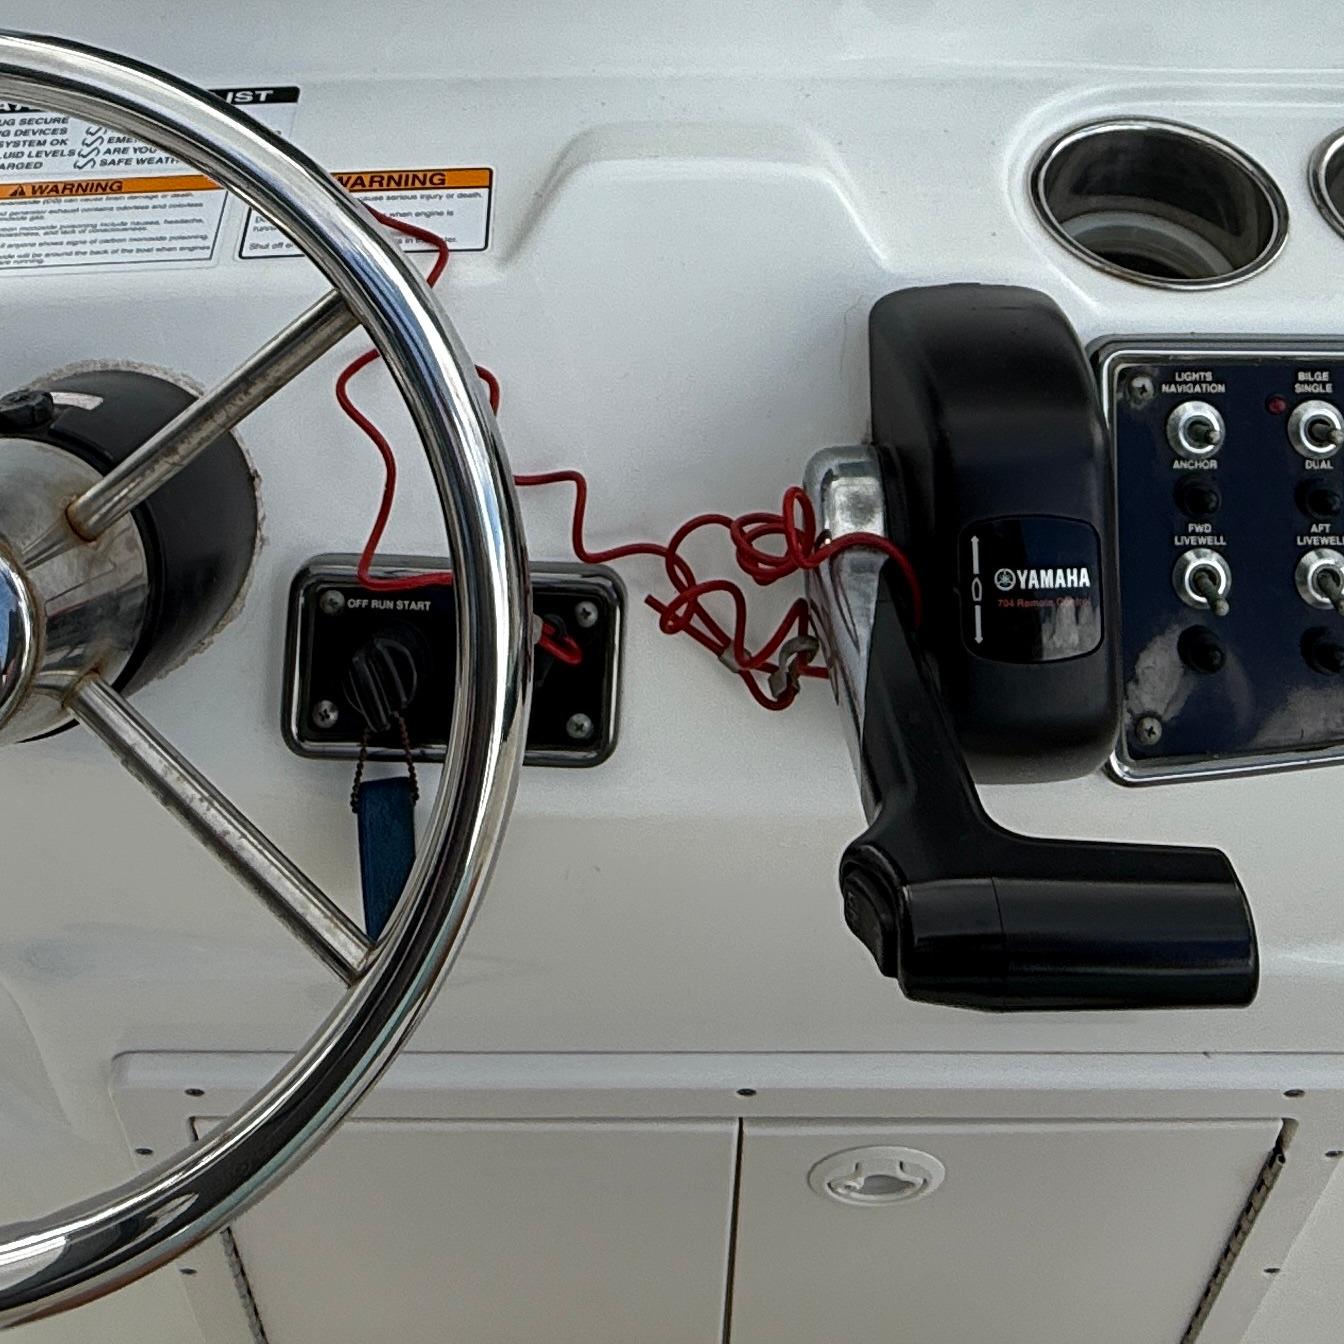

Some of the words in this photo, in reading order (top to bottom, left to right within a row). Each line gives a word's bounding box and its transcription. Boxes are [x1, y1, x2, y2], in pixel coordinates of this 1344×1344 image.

[19, 116, 70, 127] SECURE
[13, 127, 68, 138] DEVICES
[49, 137, 70, 147] OK
[26, 148, 76, 159] LEVELS
[103, 146, 131, 155] ARE
[99, 158, 134, 167] SAFE
[337, 172, 447, 189] WARNING
[31, 180, 124, 196] WARNING
[419, 193, 444, 201] injury
[414, 210, 445, 219] engine
[446, 209, 455, 217] is
[1174, 371, 1213, 382] LIGHTS
[1297, 371, 1330, 382] BILGE
[1161, 383, 1226, 393] NAVIGATION
[1294, 383, 1333, 393] SINGLE
[1172, 459, 1218, 470] ANCHOR
[1304, 459, 1334, 470] DUAL
[1187, 523, 1213, 534] FWD
[1309, 523, 1332, 534] AFT
[1173, 536, 1227, 546] LIVEWELL
[1016, 567, 1092, 590] YAMAHA
[347, 598, 369, 609] OFF
[370, 599, 394, 610] RUN
[395, 599, 432, 612] START
